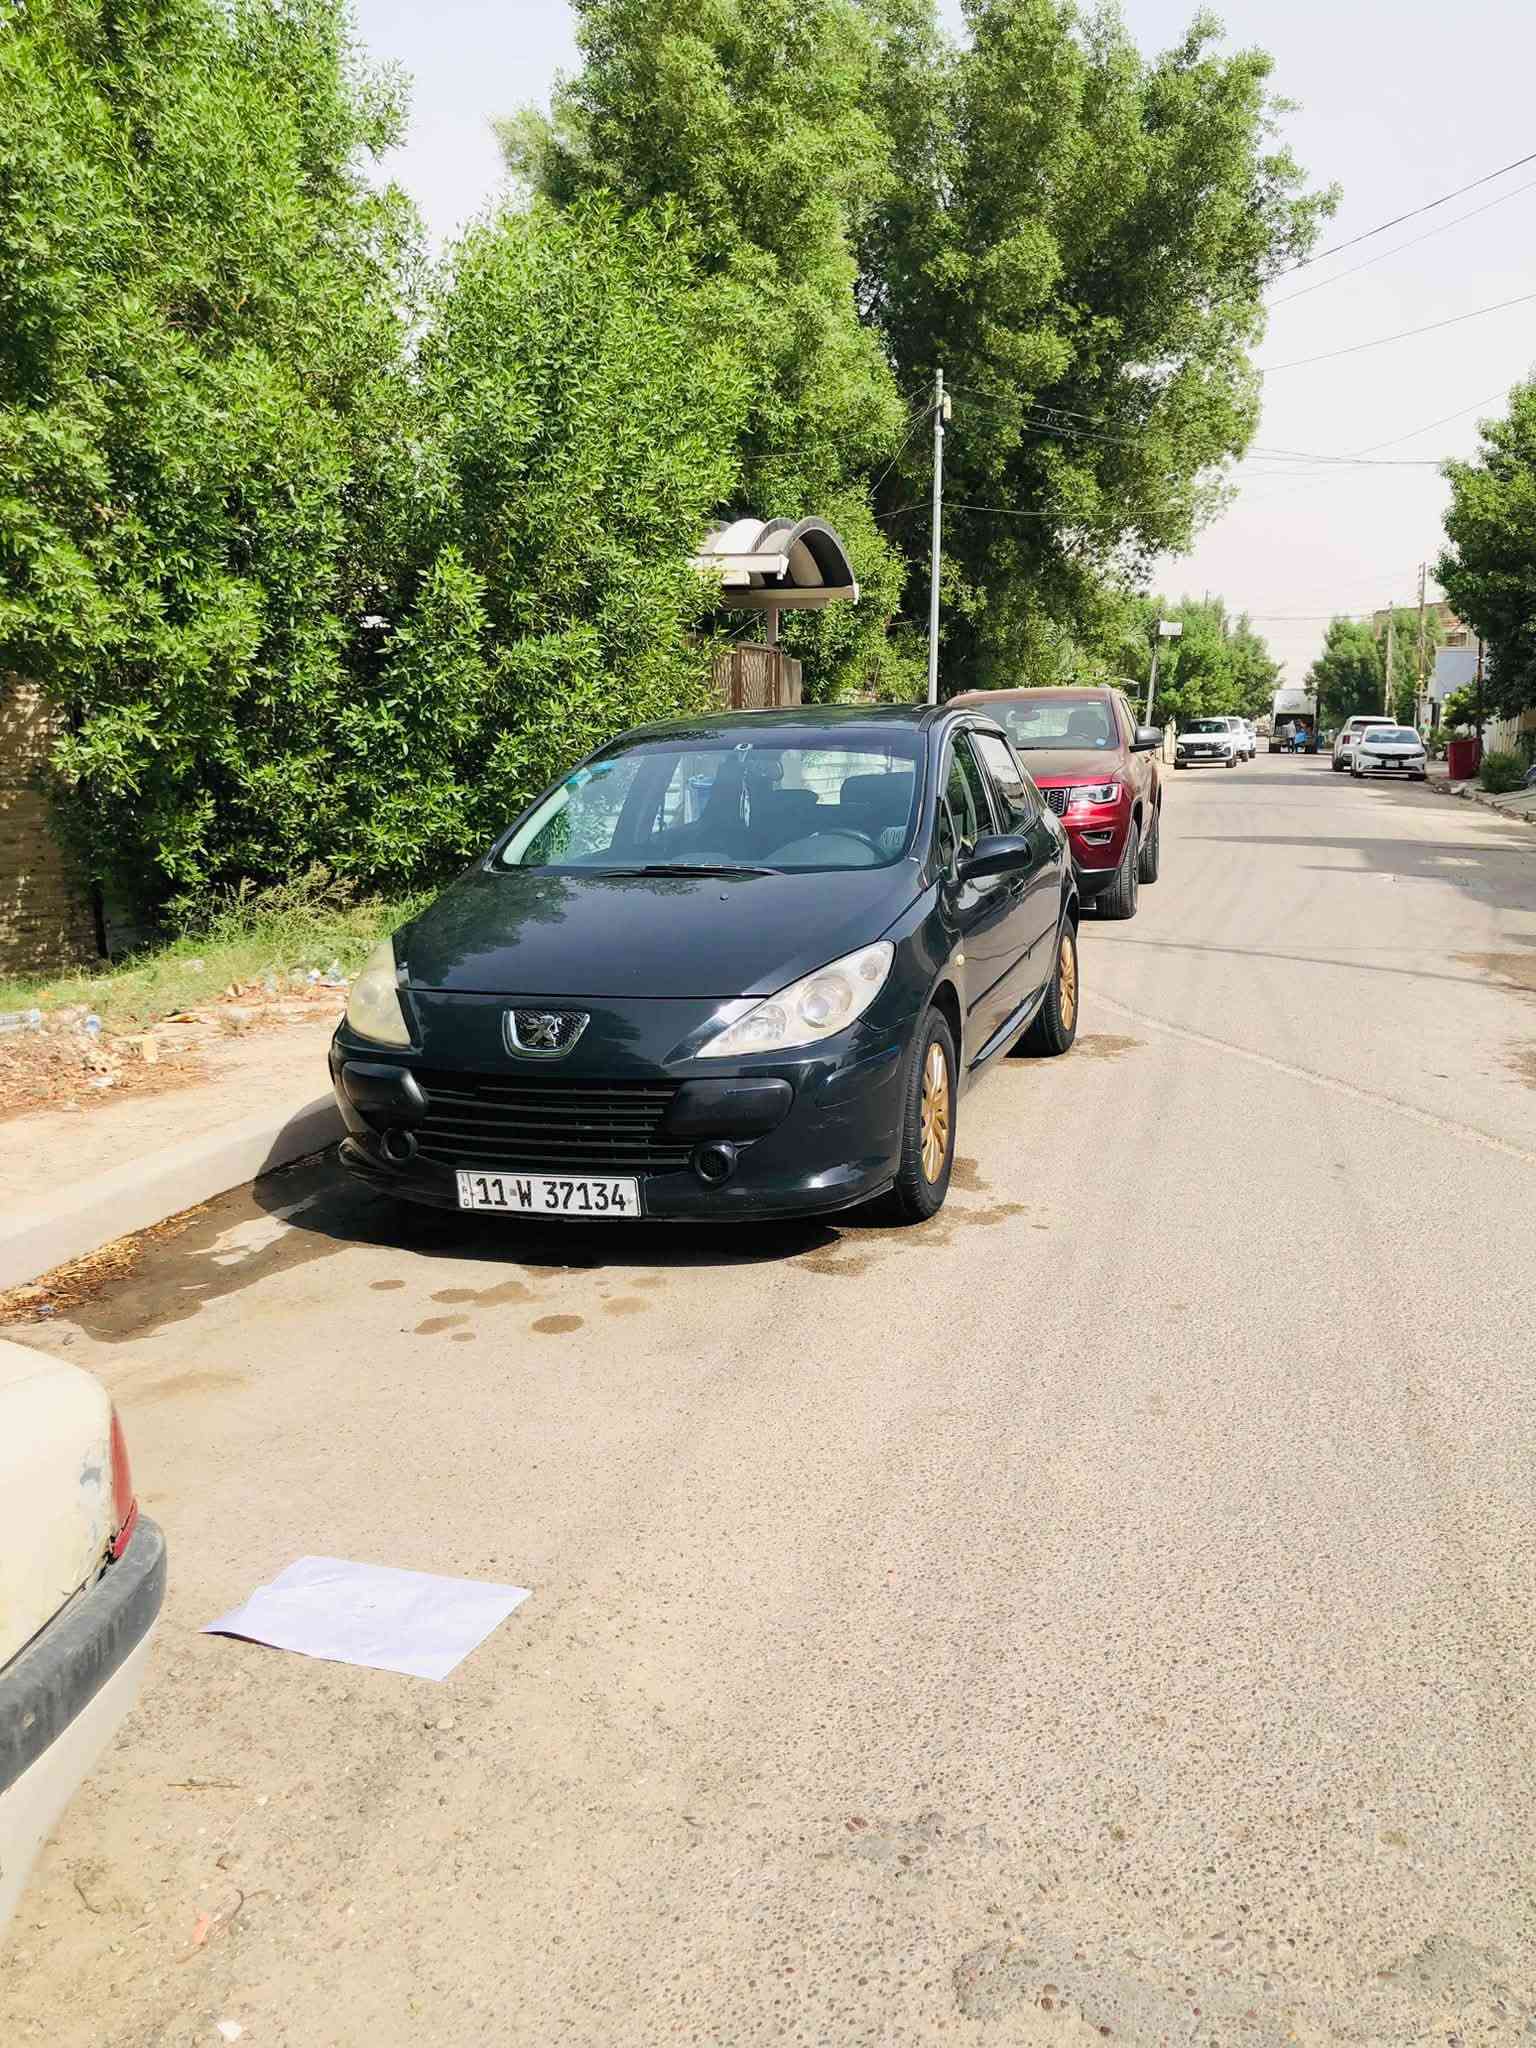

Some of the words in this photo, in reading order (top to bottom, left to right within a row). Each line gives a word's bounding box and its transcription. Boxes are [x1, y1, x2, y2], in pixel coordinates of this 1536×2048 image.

[476, 1177, 508, 1206] 11
[516, 1179, 532, 1207] W
[542, 1180, 627, 1212] 37134
